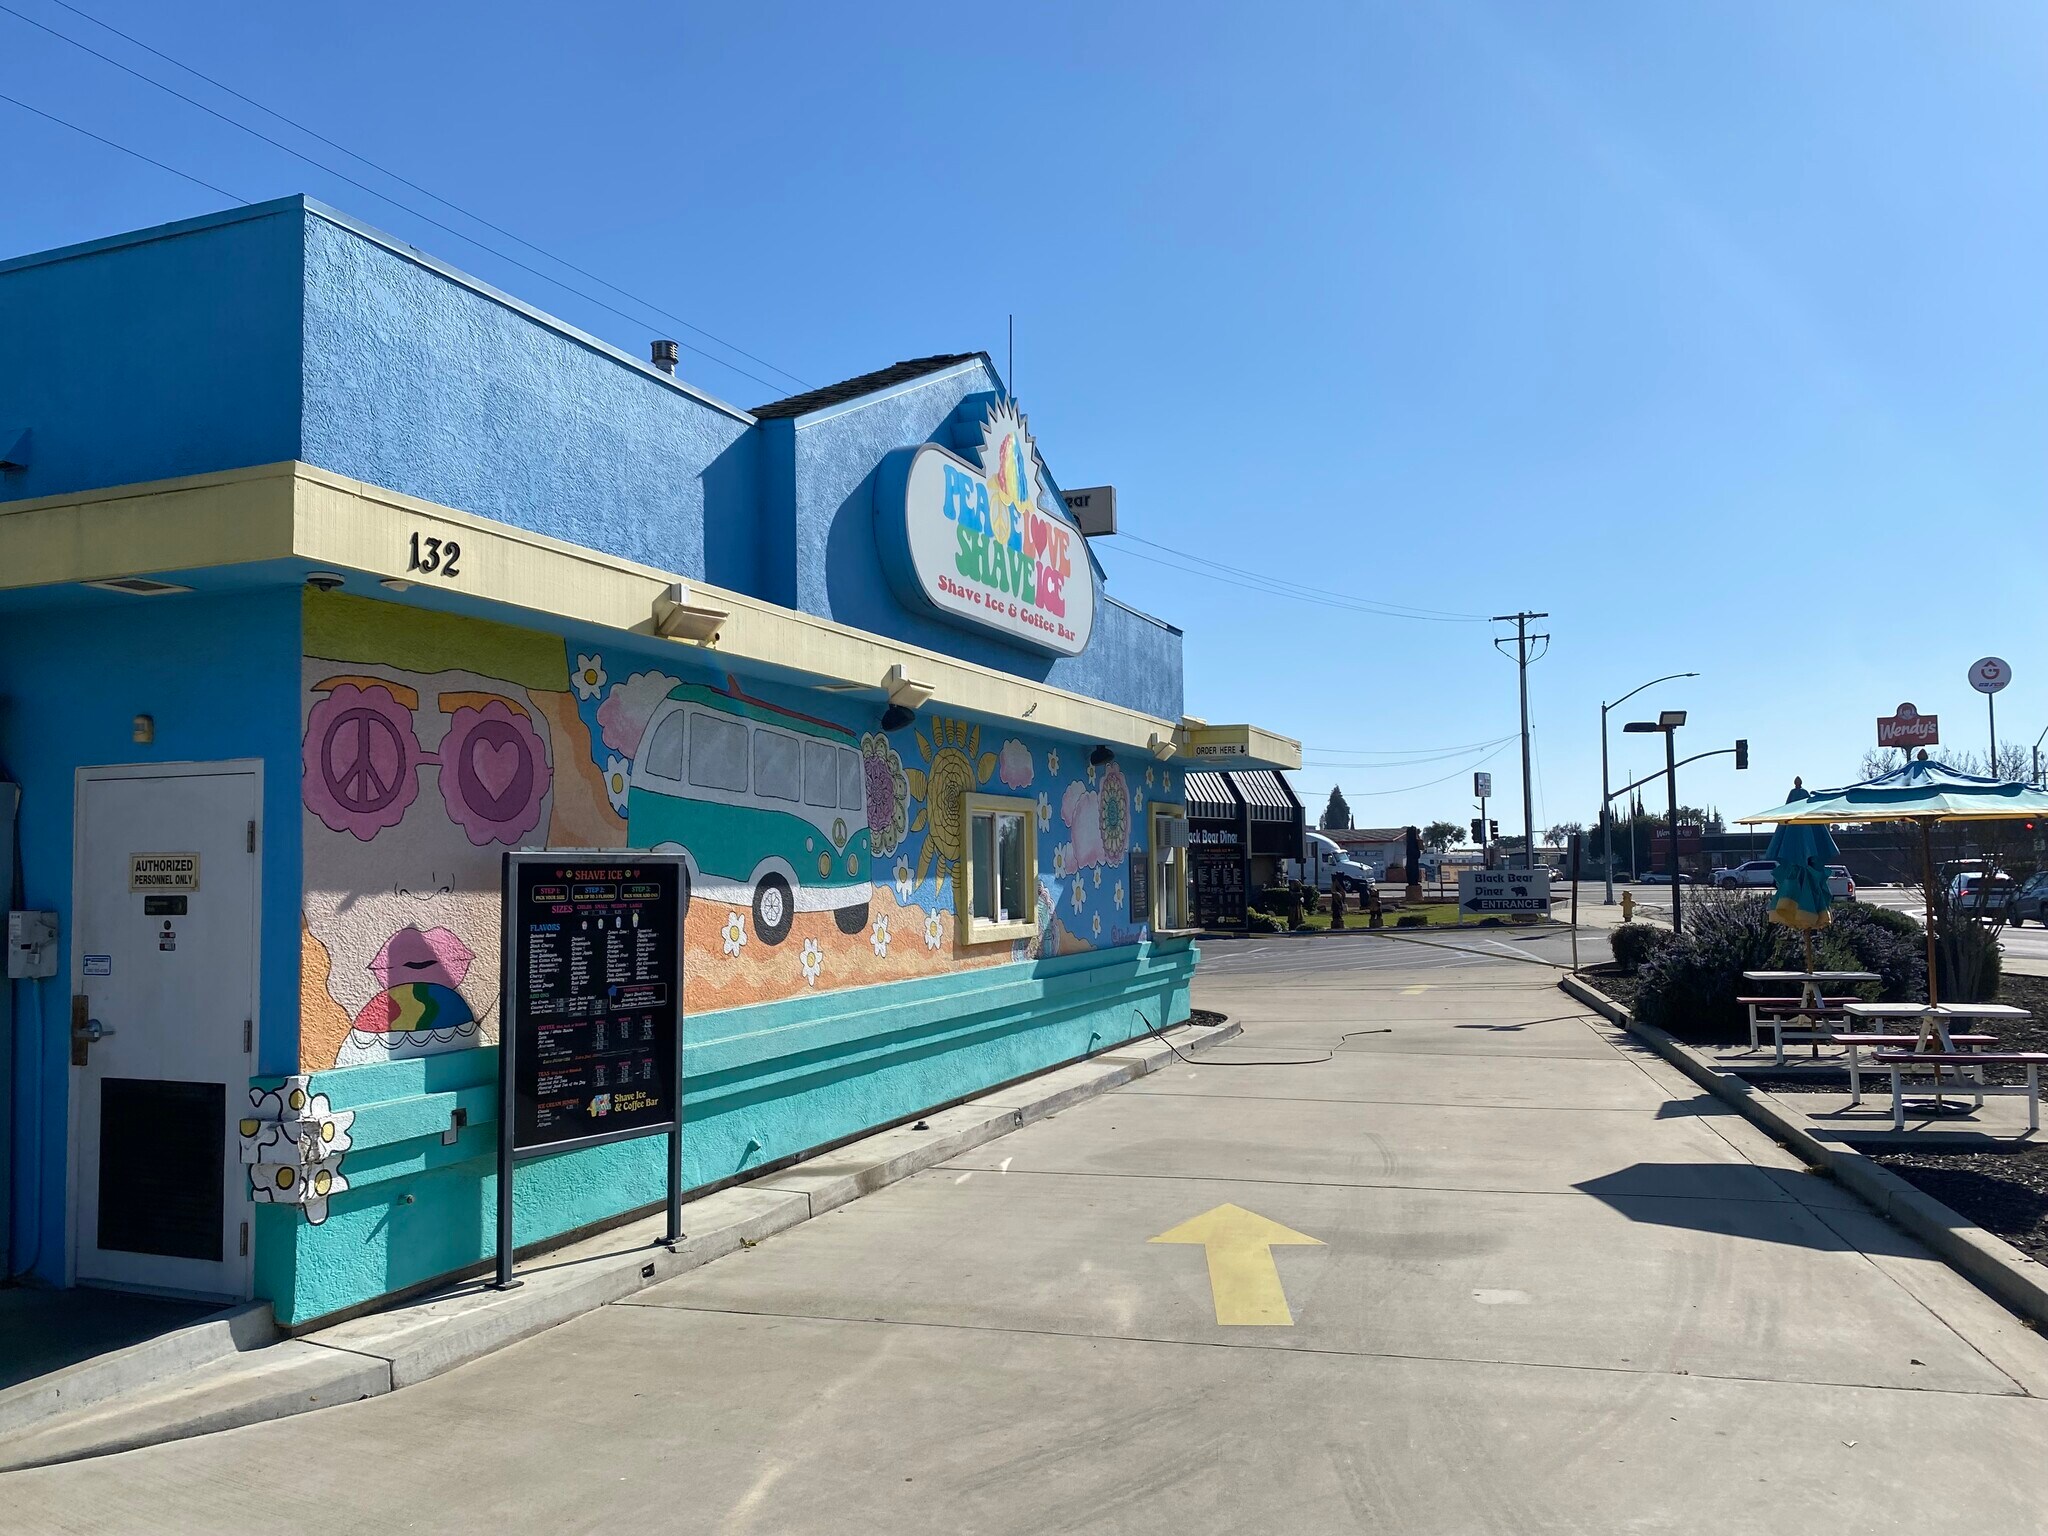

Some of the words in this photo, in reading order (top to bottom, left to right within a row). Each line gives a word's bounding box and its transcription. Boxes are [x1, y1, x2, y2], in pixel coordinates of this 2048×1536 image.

[1023, 510, 1071, 578] LOVE
[409, 532, 462, 578] 132
[956, 523, 1036, 606] SHAVE
[1035, 560, 1066, 618] ICE
[938, 575, 981, 604] Shave
[985, 592, 1005, 613] Ice
[1008, 604, 1018, 618] &
[1020, 608, 1055, 634] Coffee
[1058, 622, 1076, 642] Bar
[1881, 719, 1936, 741] Wendy's
[1196, 745, 1217, 755] ORDER
[1220, 745, 1236, 754] HERE
[1188, 829, 1201, 844] ack
[1202, 829, 1219, 844] Bear
[1220, 830, 1238, 844] Diner
[136, 860, 193, 872] AUTHORIZED
[135, 875, 173, 885] PERSONNEL
[175, 874, 193, 884] ONLY
[575, 870, 606, 880] SHAVE
[608, 870, 623, 880] ICE
[1475, 874, 1504, 883] Black
[1508, 874, 1533, 882] Bear
[1476, 887, 1504, 896] Diner
[552, 905, 573, 914] SIZES
[1482, 900, 1539, 908] ENTRANCE
[530, 924, 561, 932] FLAVORS
[615, 1093, 635, 1103] Shave
[636, 1091, 647, 1099] Ice
[615, 1103, 622, 1112] &
[623, 1100, 644, 1111] Coffee
[646, 1098, 659, 1107] Bar
